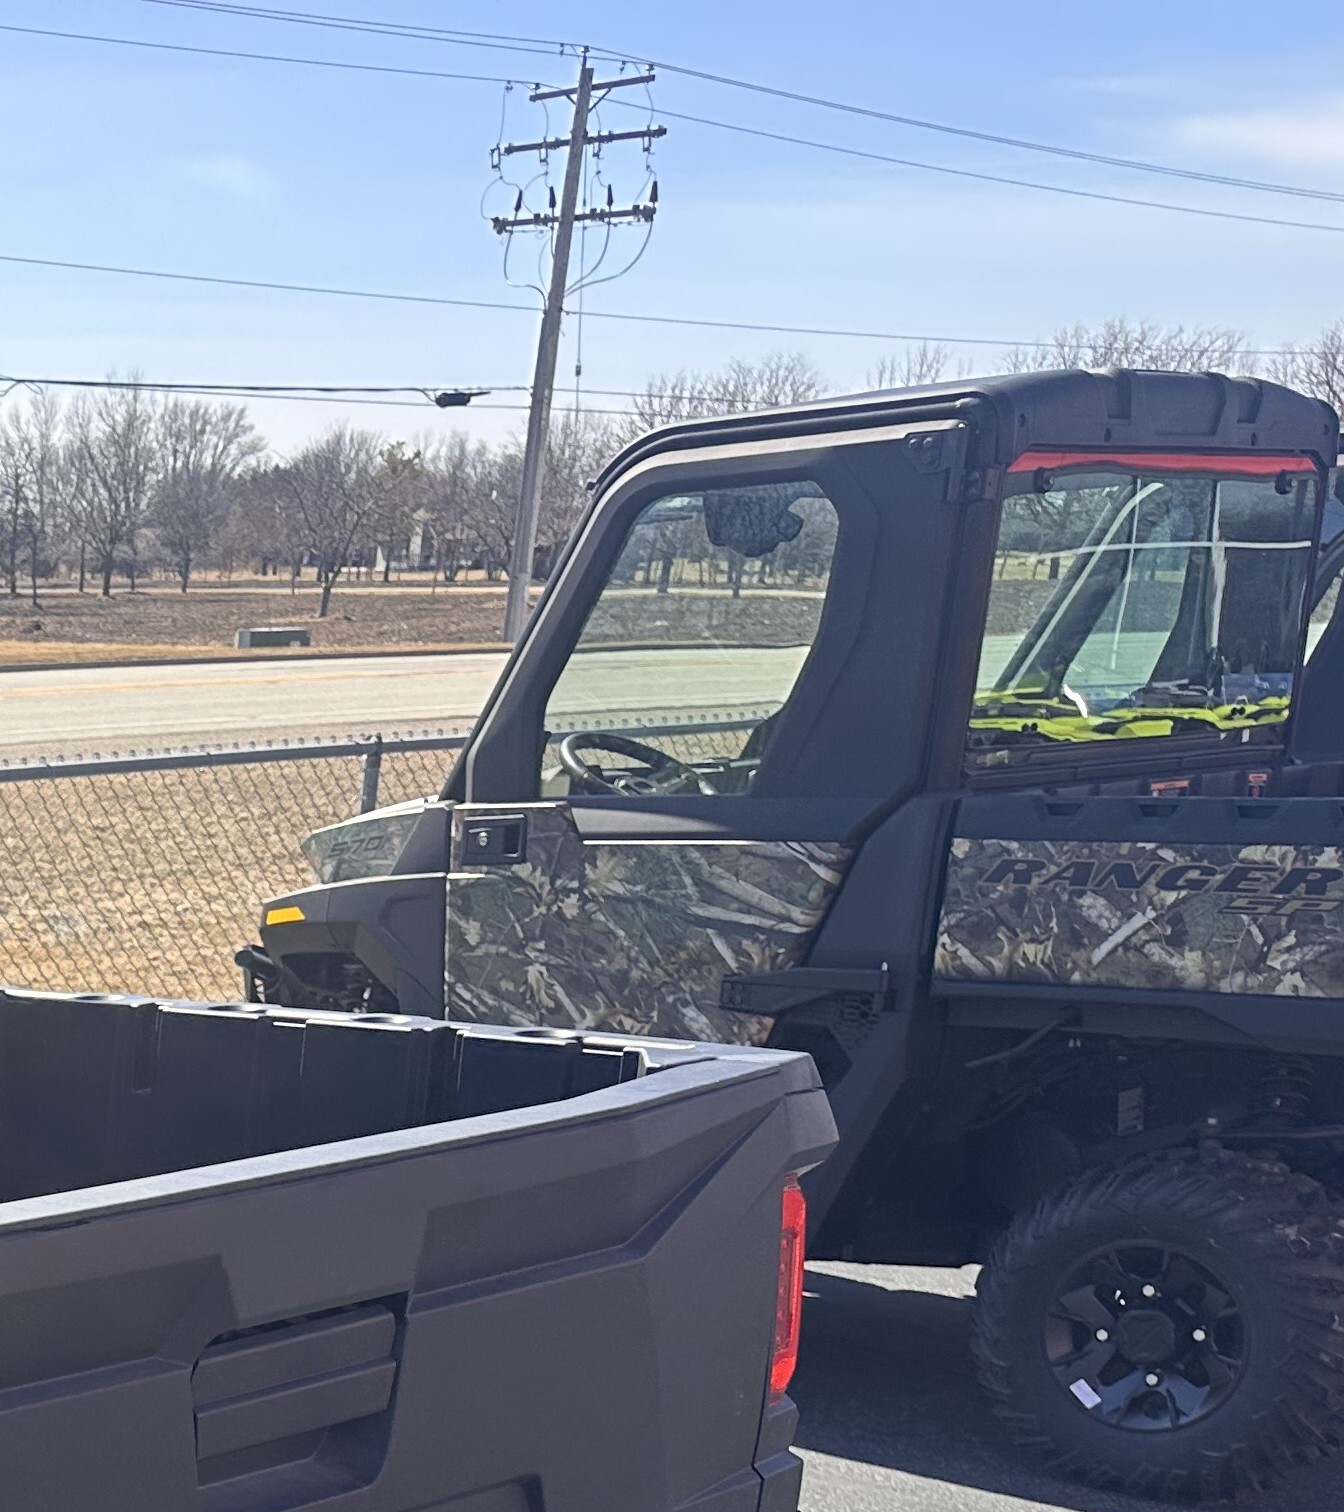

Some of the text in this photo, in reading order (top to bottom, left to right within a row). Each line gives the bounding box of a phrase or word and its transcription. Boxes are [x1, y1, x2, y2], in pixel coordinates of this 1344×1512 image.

[328, 835, 385, 858] 570
[981, 858, 1343, 896] RANGER
[1220, 898, 1341, 914] SP
